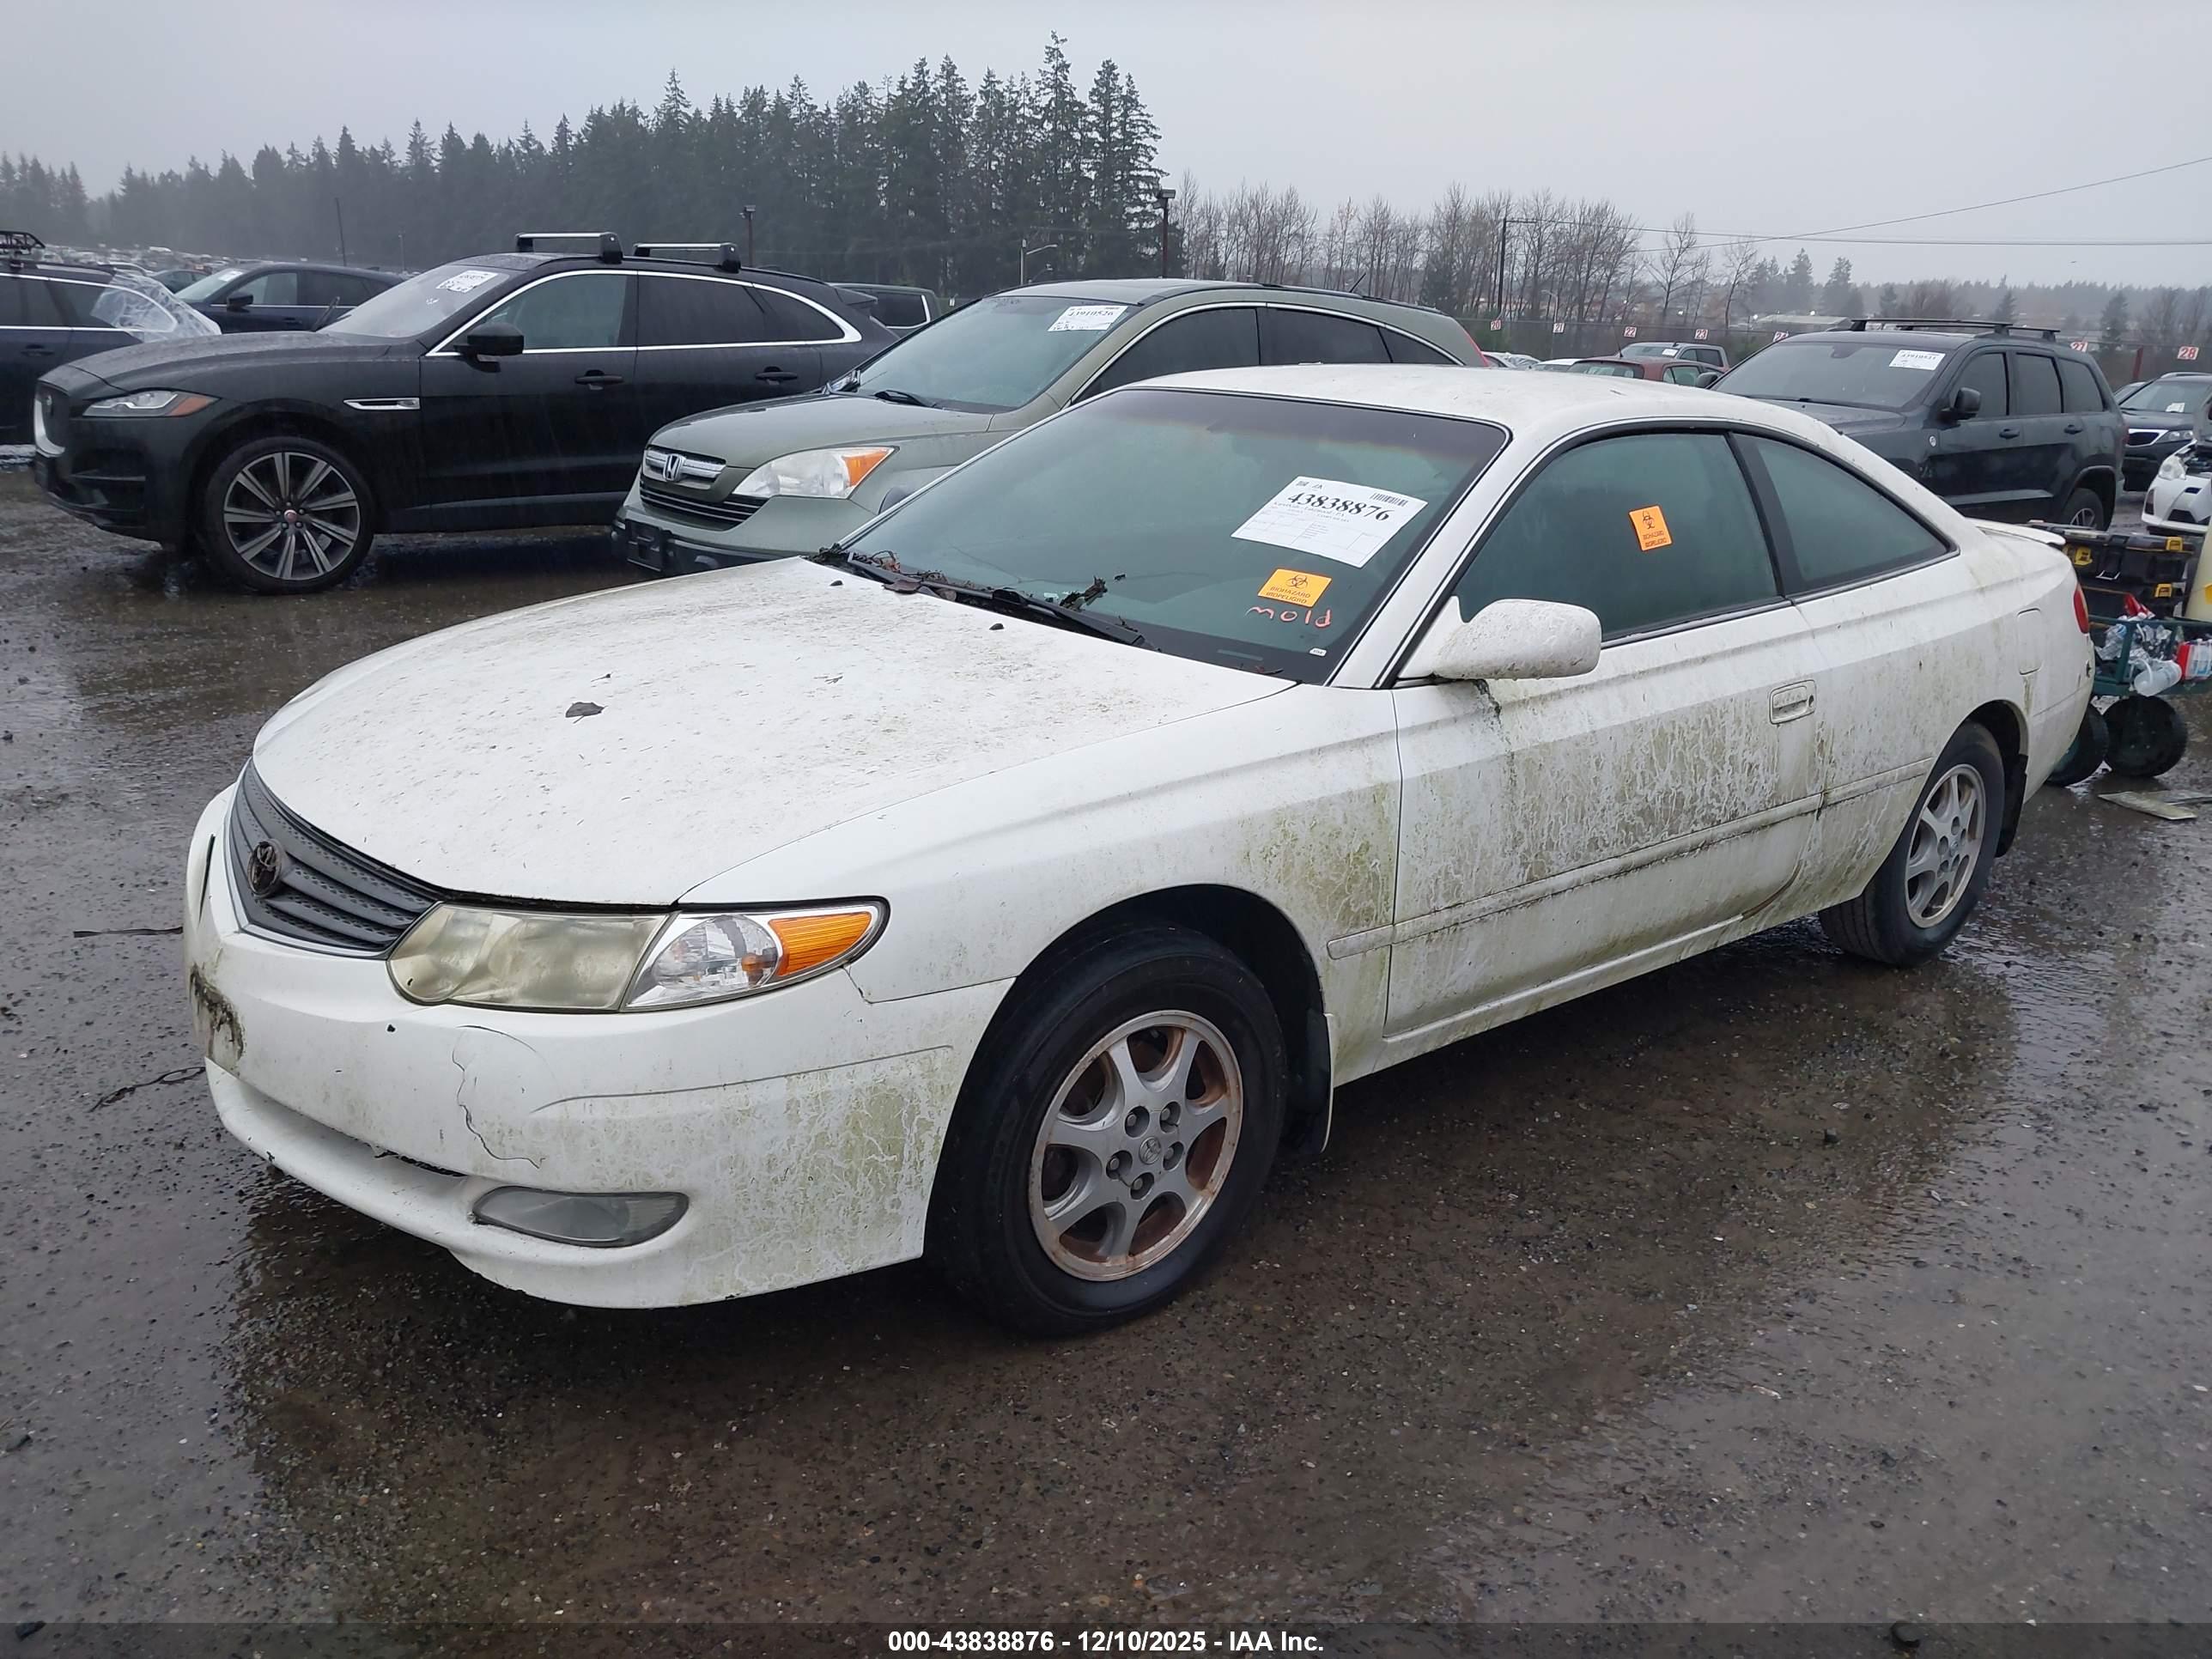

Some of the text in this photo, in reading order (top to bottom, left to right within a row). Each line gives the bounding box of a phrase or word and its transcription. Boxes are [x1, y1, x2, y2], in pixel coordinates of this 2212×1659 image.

[1491, 320, 1501, 330] 20
[1625, 327, 1636, 337] 22
[1697, 330, 1707, 339] 23
[2179, 347, 2197, 359] 28
[1288, 492, 1395, 521] 43838876
[1269, 586, 1311, 599] BIOHAZARD
[1245, 606, 1331, 627] mold
